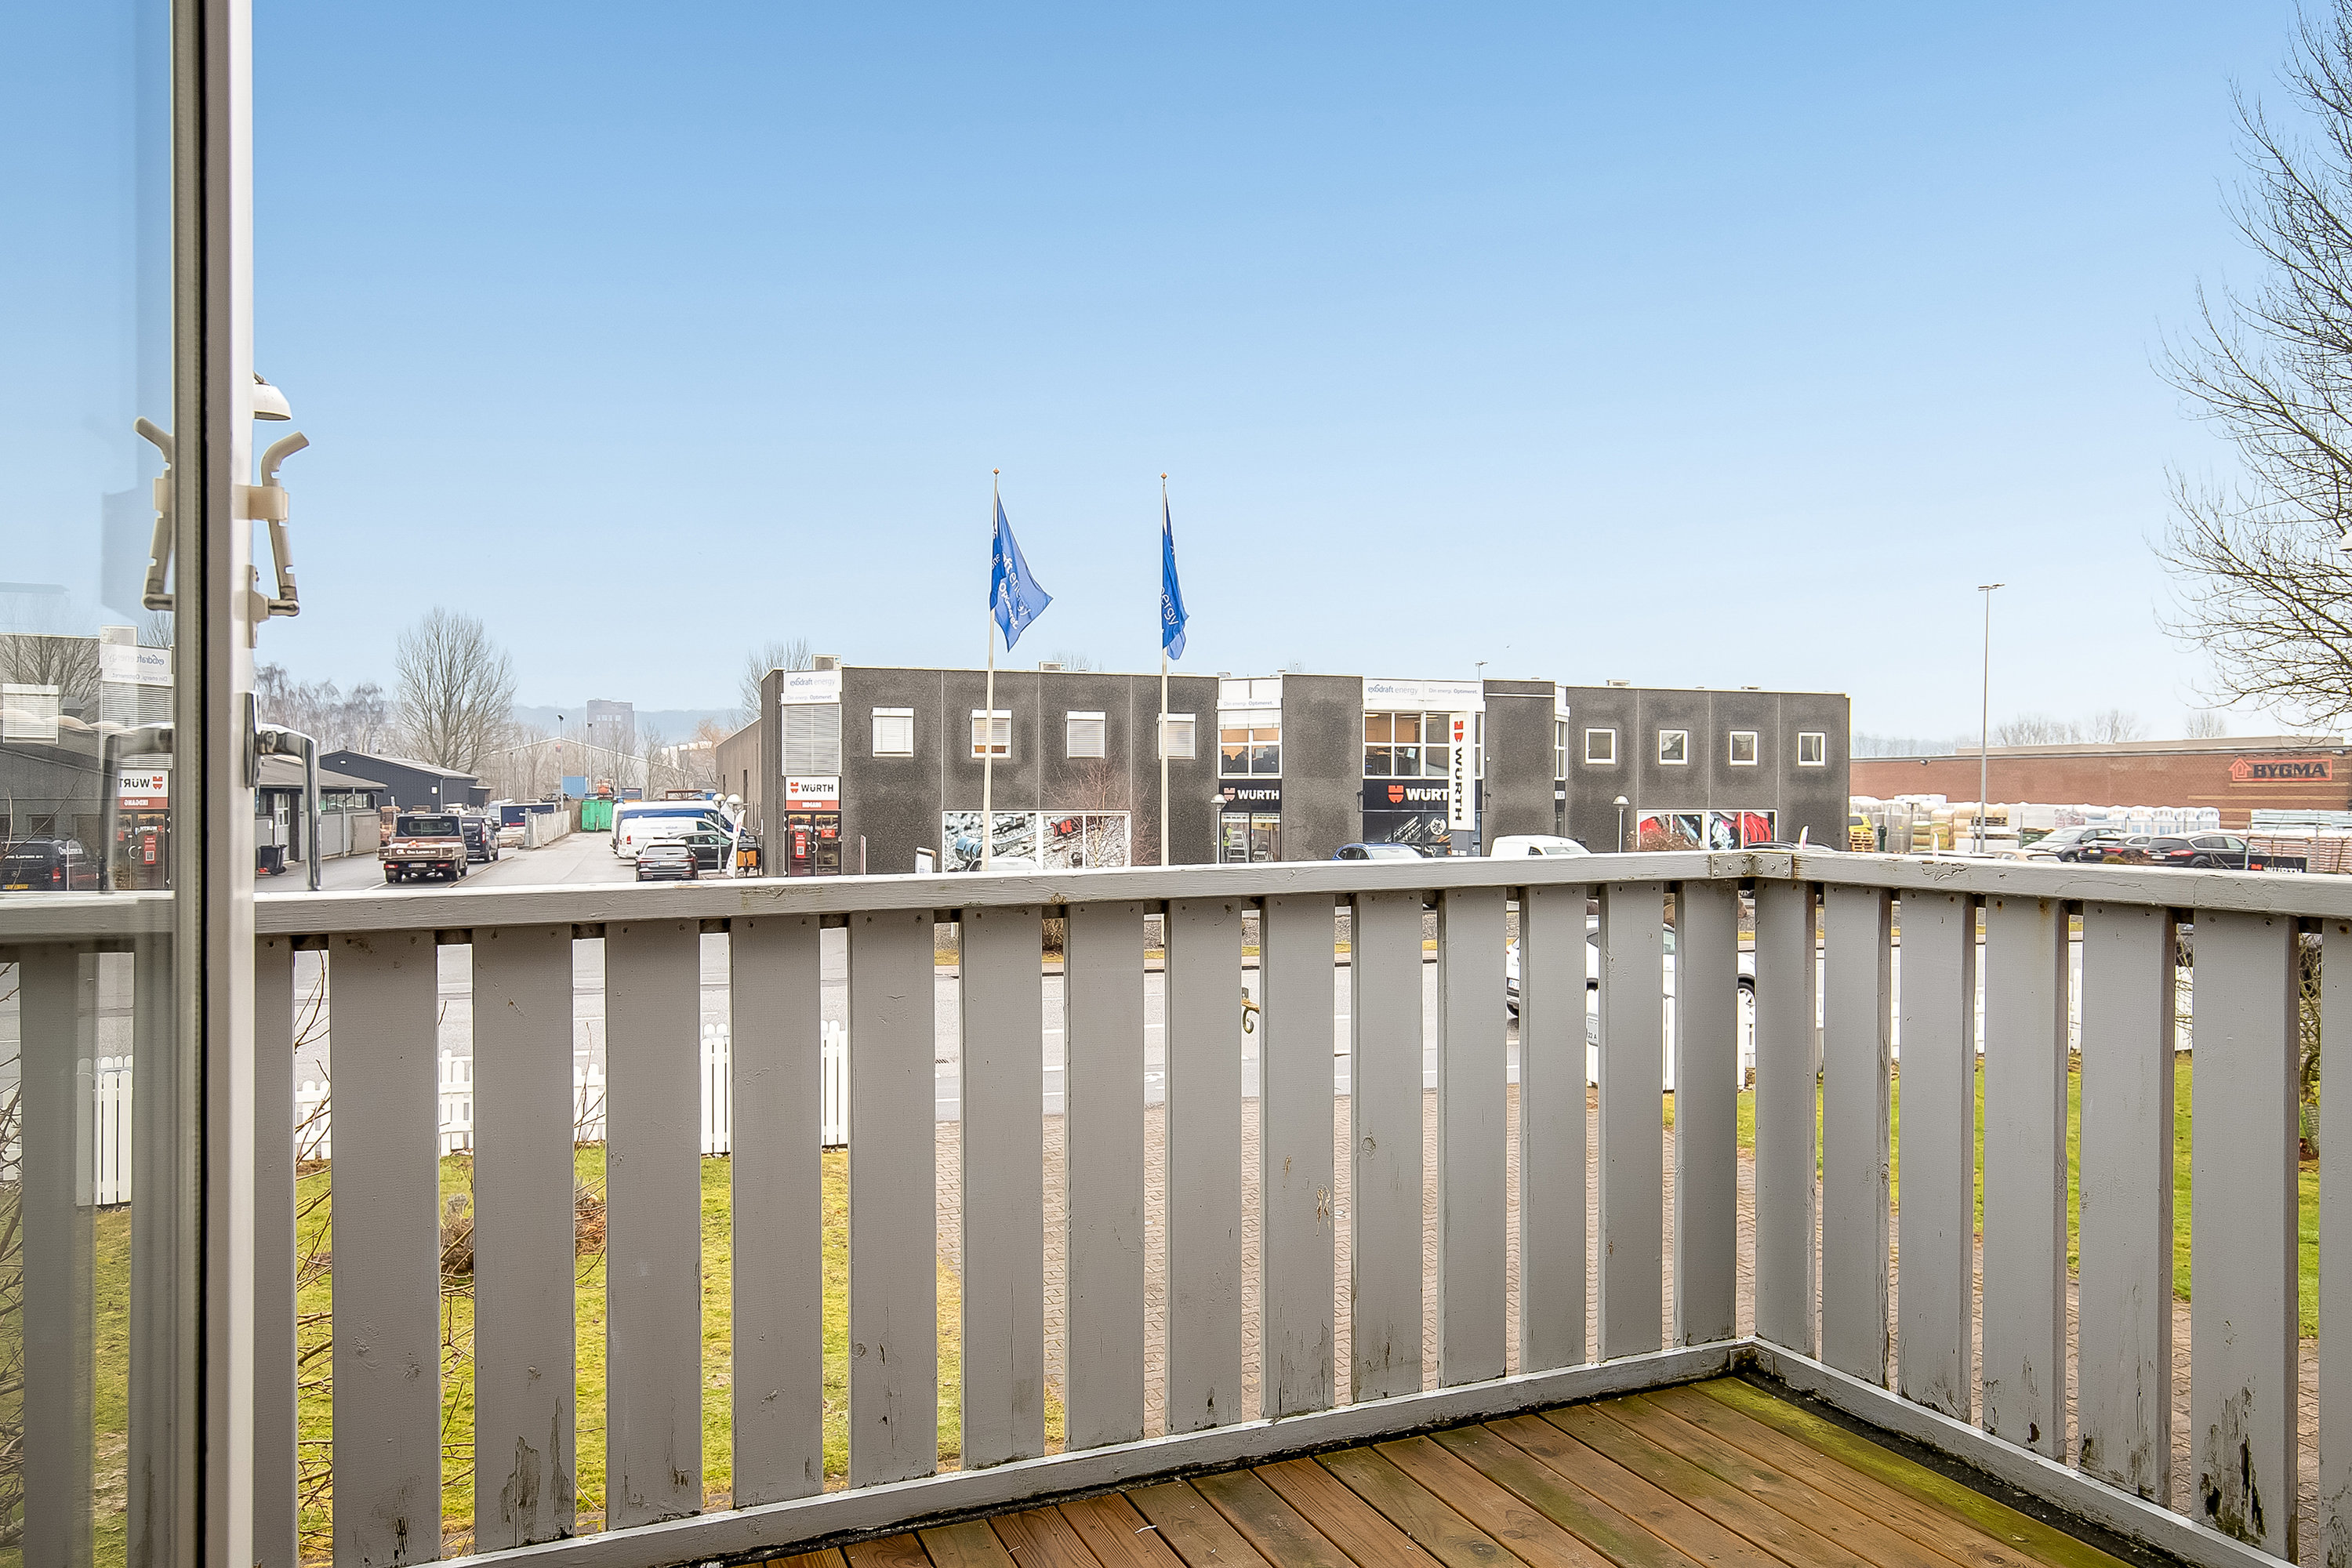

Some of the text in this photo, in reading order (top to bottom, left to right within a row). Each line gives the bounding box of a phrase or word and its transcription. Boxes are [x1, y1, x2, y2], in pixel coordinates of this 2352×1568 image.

[1367, 684, 1418, 695] exodraft energy
[2253, 764, 2326, 778] BYGMA
[801, 783, 833, 793] WÜRTH
[1406, 788, 1450, 801] WÜRT
